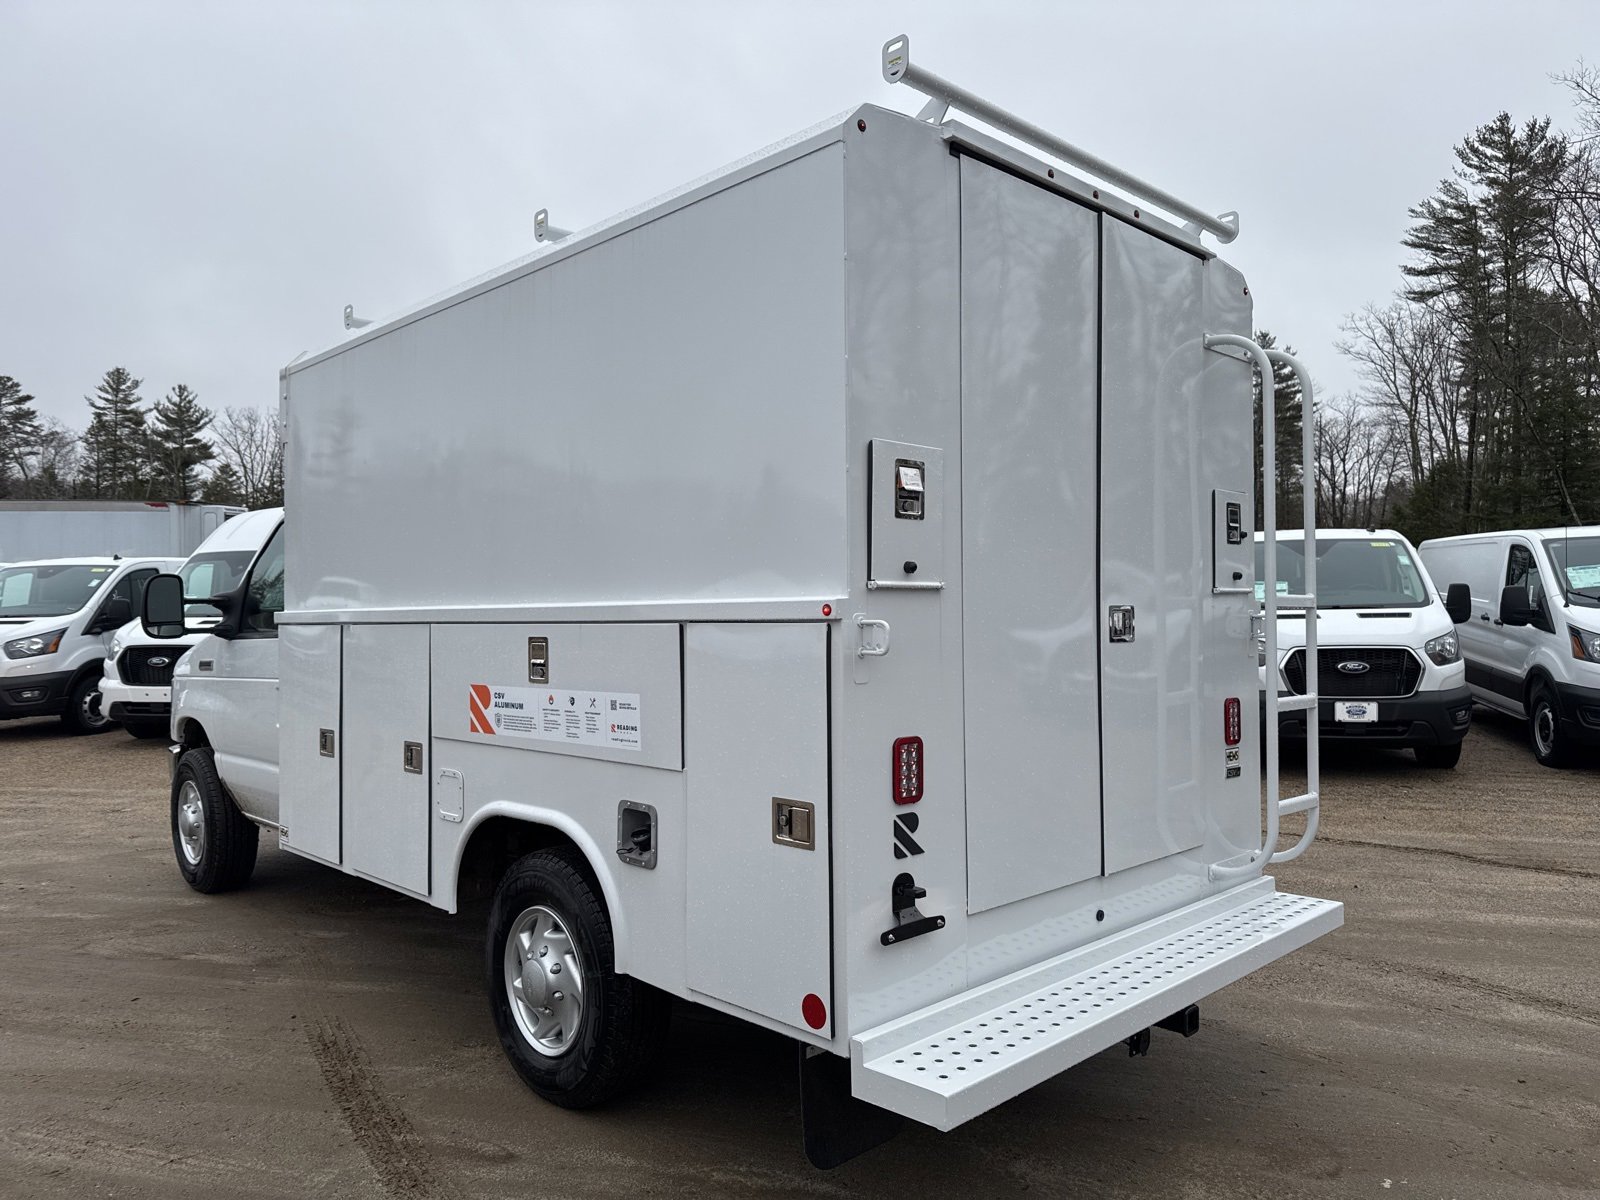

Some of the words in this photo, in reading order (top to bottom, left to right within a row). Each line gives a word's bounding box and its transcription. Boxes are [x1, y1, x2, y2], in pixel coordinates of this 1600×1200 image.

[493, 692, 505, 700] CSV
[494, 701, 524, 710] ALUMINUM
[616, 724, 638, 732] READING
